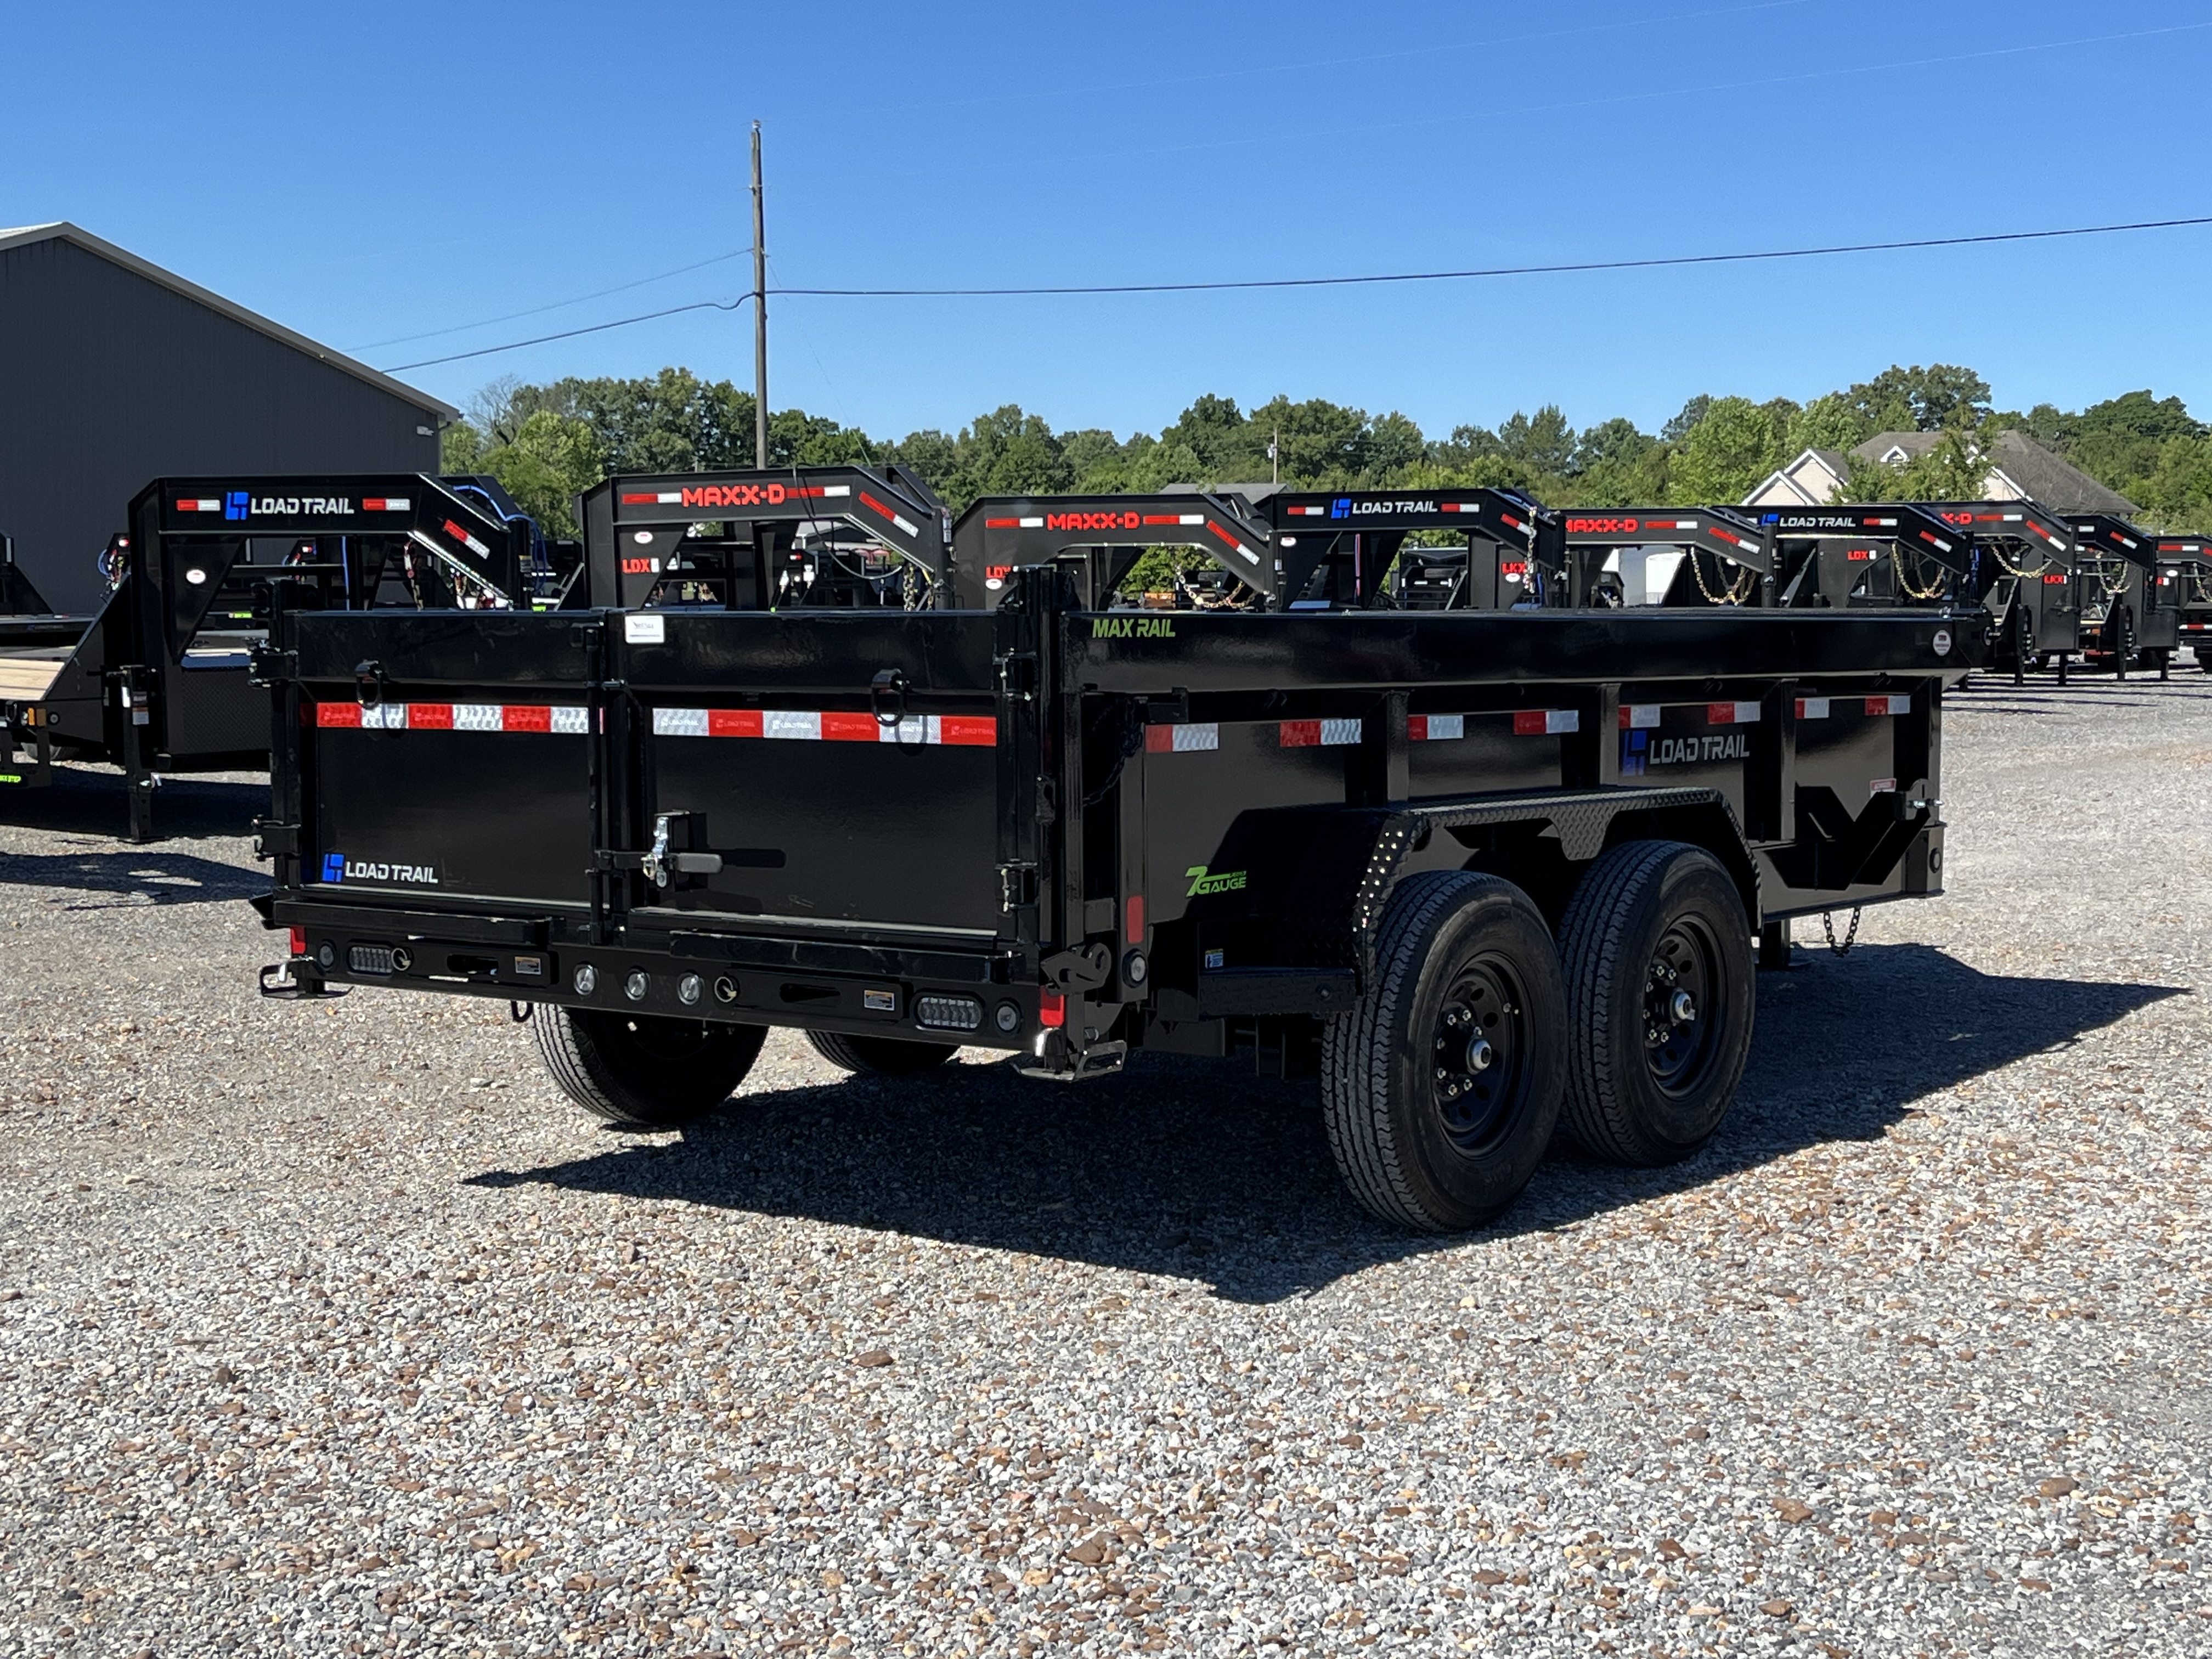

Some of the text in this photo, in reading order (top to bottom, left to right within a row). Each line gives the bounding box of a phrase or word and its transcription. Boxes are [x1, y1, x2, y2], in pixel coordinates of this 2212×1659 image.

[682, 483, 785, 507] MAXX-D
[251, 498, 354, 514] LOAD TRAIL
[1352, 500, 1438, 514] LOAD TRAIL
[1047, 512, 1140, 531] MAXX-D
[1779, 517, 1856, 527] LOAD TRAIL
[1092, 618, 1176, 638] MAX RAIL
[1650, 734, 1750, 765] LOAD TRAIL
[345, 861, 438, 884] LOAD TRAIL
[1185, 866, 1247, 898] 7 GAUGE
